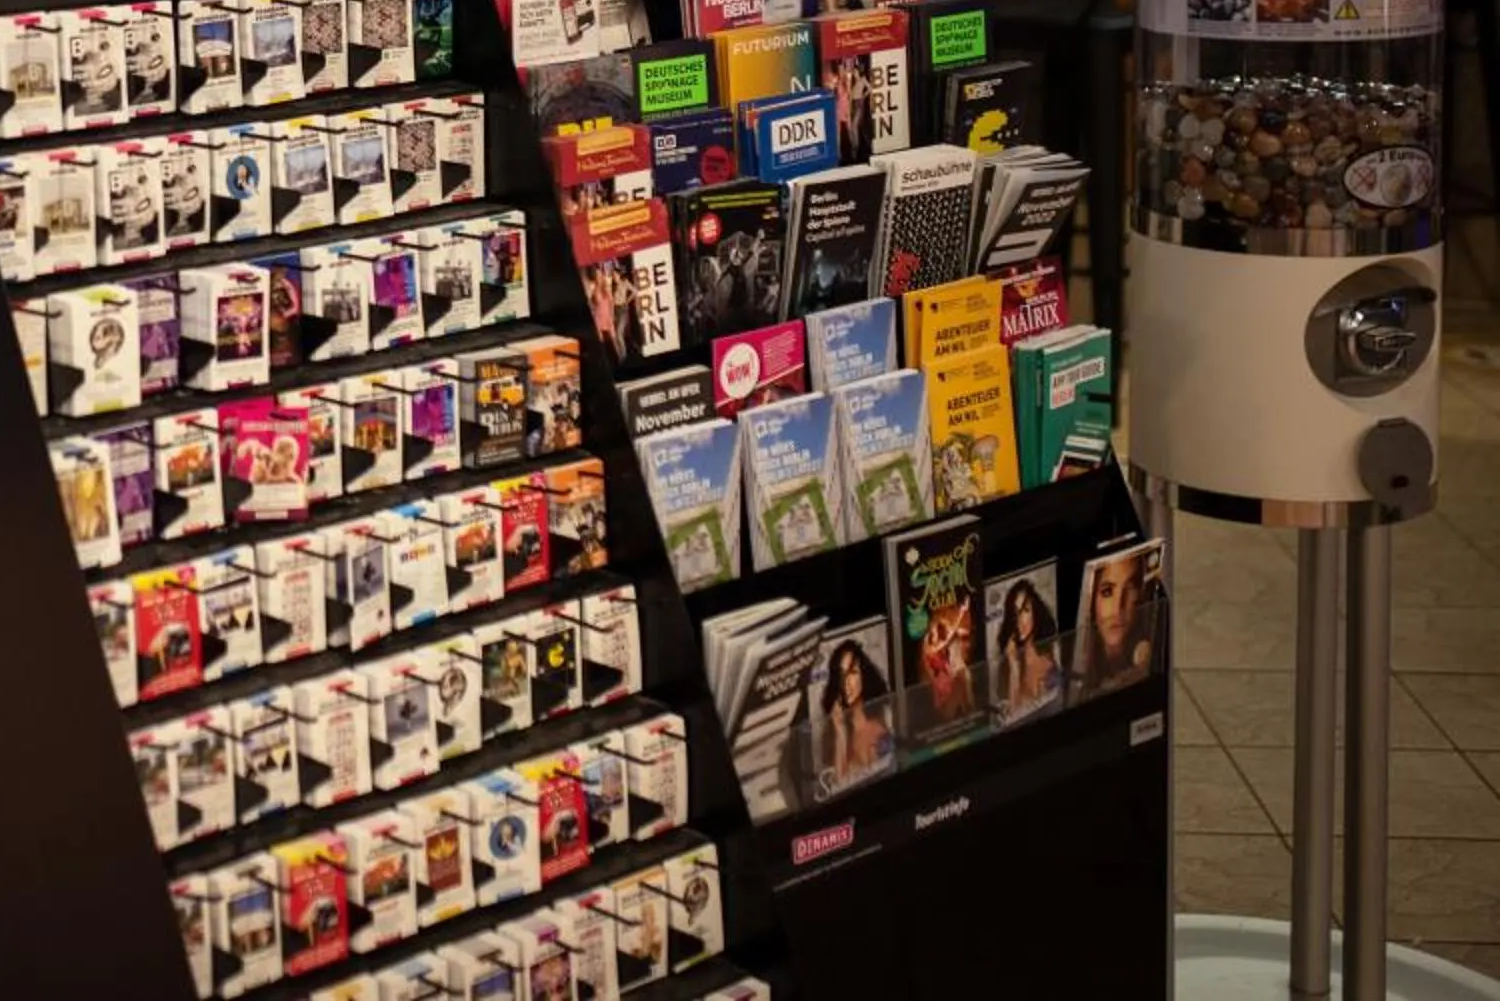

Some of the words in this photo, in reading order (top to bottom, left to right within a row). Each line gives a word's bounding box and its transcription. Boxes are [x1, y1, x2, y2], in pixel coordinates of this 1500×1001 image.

[723, 0, 765, 19] BERLIN
[732, 30, 810, 56] FUTURIUM
[644, 59, 706, 80] DEUTSCHES
[871, 63, 899, 89] BE
[644, 74, 700, 93] SPIONAGE
[645, 89, 693, 106] MUSEUM
[871, 90, 899, 115] RL
[779, 118, 818, 146] DDR
[901, 159, 973, 185] schaubühne
[633, 260, 669, 291] BE
[638, 290, 670, 319] RL
[935, 319, 991, 342] ABENTEUER
[1002, 301, 1061, 338] MATRIX
[934, 342, 951, 357] AM
[947, 386, 1001, 411] ABENTEUER
[635, 403, 707, 433] November
[948, 412, 964, 427] AM
